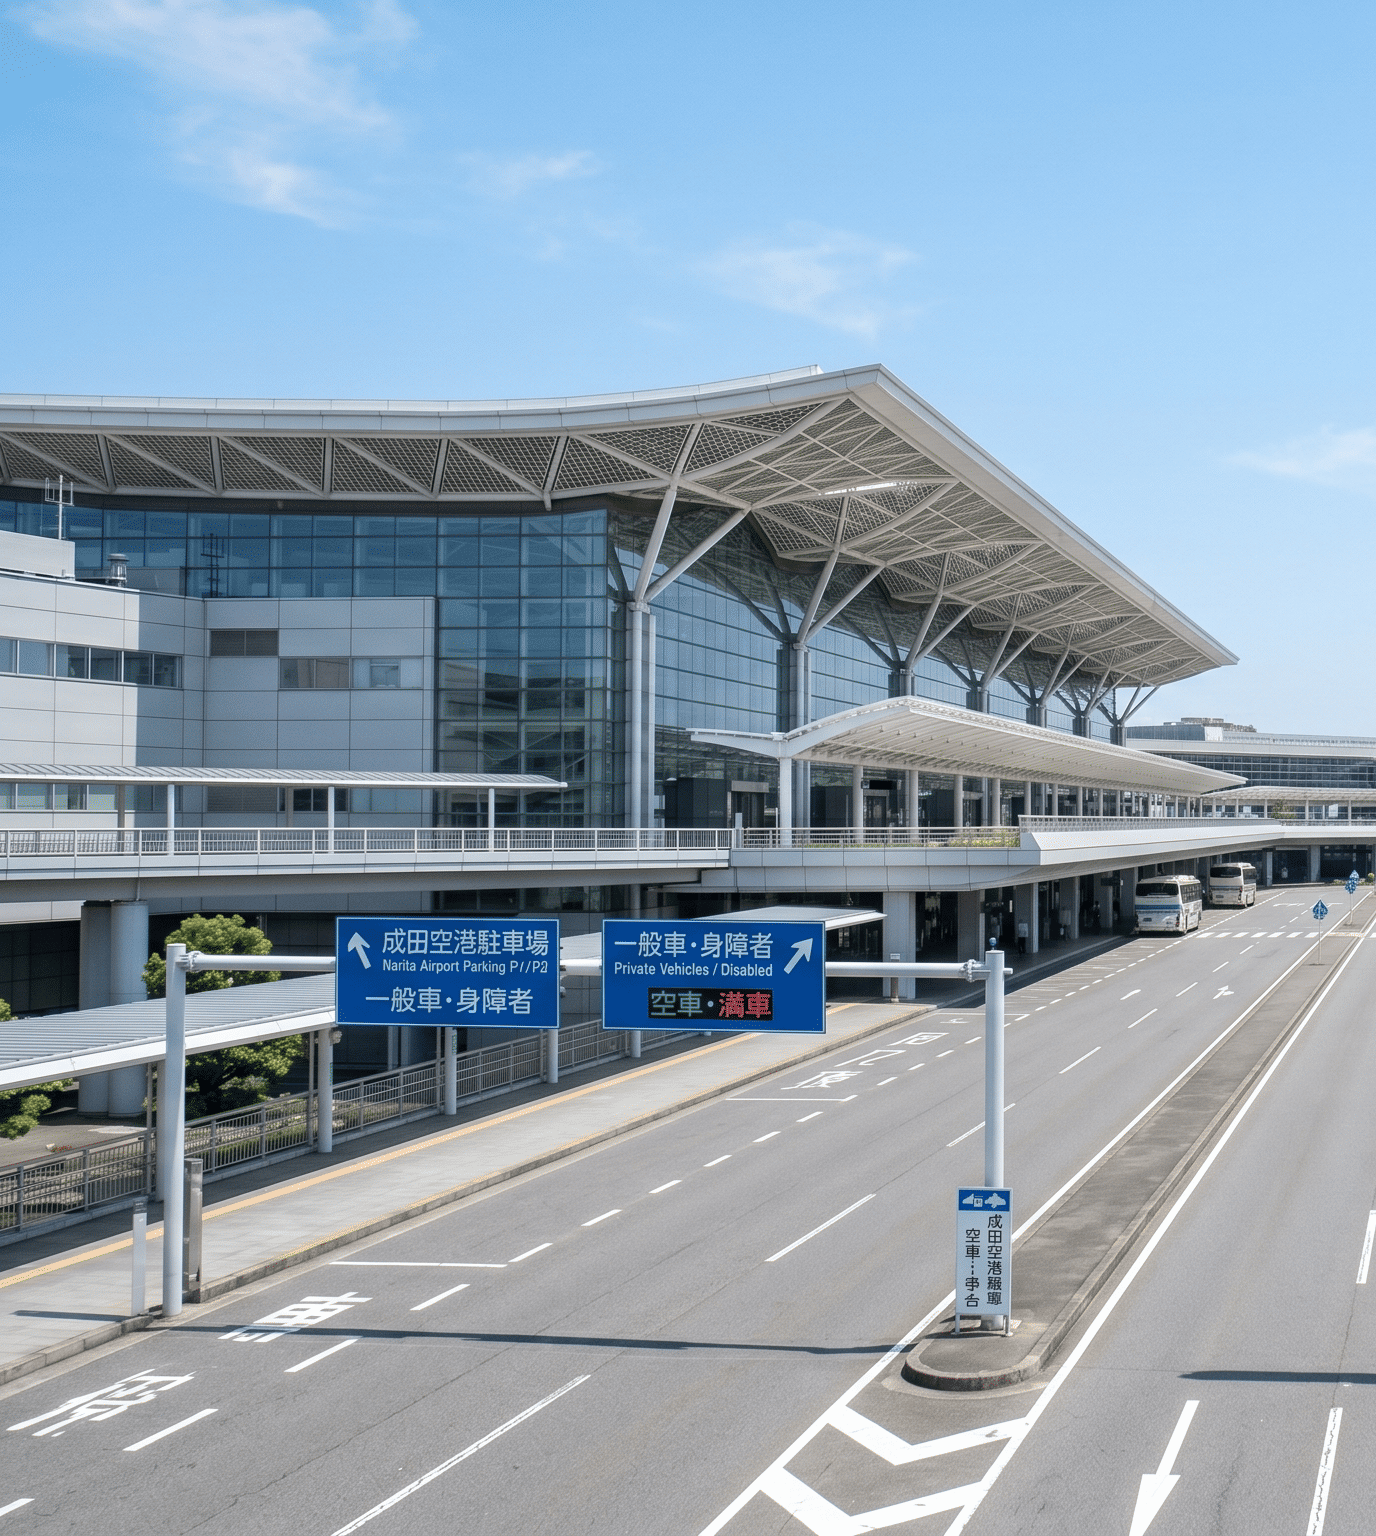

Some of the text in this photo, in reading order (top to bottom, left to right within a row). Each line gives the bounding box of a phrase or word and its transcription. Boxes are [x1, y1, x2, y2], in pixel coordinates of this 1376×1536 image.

[382, 928, 549, 956] 成田空港駐車場
[383, 959, 417, 972] Narita
[420, 960, 460, 975] Airport
[464, 960, 506, 976] Parking
[615, 962, 773, 977] Private Vehicles / Disabled
